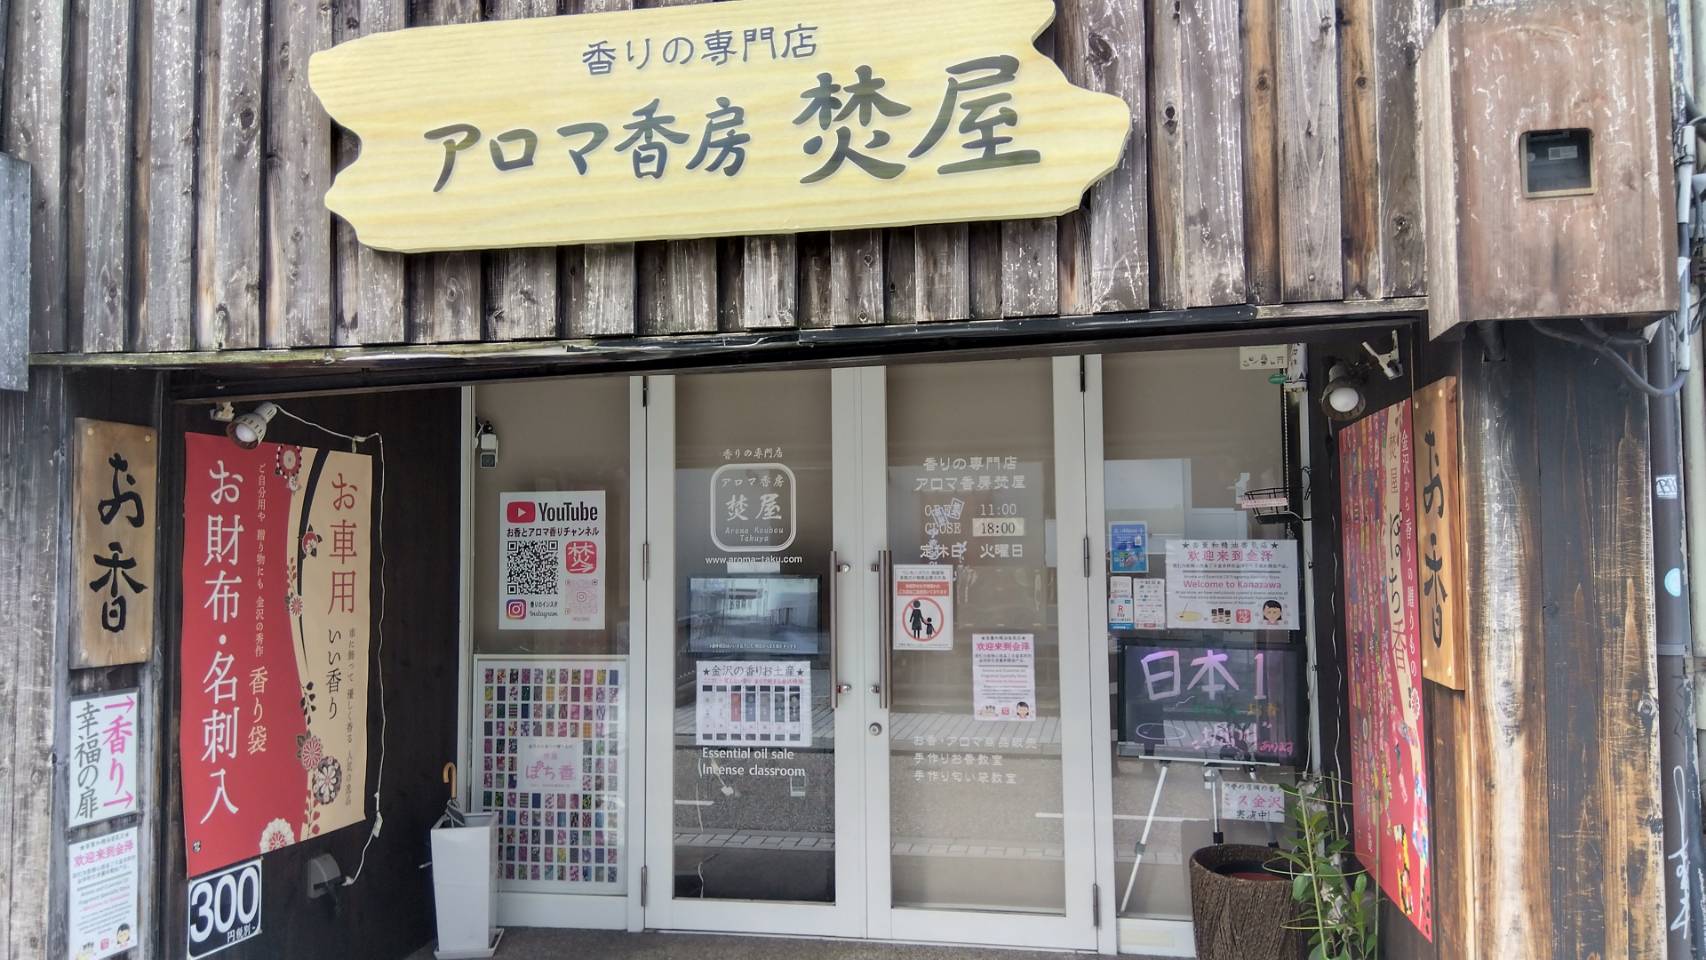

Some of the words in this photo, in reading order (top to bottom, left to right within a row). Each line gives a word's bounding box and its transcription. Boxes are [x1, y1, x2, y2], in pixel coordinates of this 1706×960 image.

[582, 24, 819, 76] 香りの専門店
[424, 96, 752, 194] アロマ香房
[792, 54, 1042, 185] 焚屋
[722, 447, 784, 460] 香りの専門店
[923, 456, 1018, 472] 香りの専門店
[721, 475, 785, 488] アロマ香房
[914, 475, 1027, 491] アロマ香房焚屋
[538, 501, 598, 522] YouTube
[725, 493, 782, 522] 焚屋
[980, 504, 1017, 516] 11:00
[506, 526, 600, 538] お香とアロマ香りチャンネル
[981, 522, 1016, 535] 18:00
[88, 452, 149, 633] お香
[328, 472, 358, 616] お車用
[1422, 429, 1448, 649] お香
[920, 543, 961, 559] 定休日
[980, 543, 1023, 559] 火曜日
[1187, 549, 1273, 562] 欢迎来到金泽
[705, 555, 803, 565] www.aroma-taku.com
[1183, 580, 1224, 589] Welcome
[1226, 580, 1235, 589] to
[1238, 580, 1282, 589] Kanazawa
[200, 459, 245, 826] お財布・名刺入
[326, 628, 342, 720] いい香り
[711, 664, 795, 678] 金沢の香りお土産
[248, 665, 269, 755] 香り袋
[74, 701, 101, 819] 幸福の扉
[102, 714, 133, 797] 香り
[702, 746, 751, 759] Essential
[754, 747, 768, 760] oil
[771, 748, 794, 760] sale
[913, 752, 1003, 766] 手作りお香教室
[749, 763, 806, 777] classroom
[190, 866, 259, 943] 300
